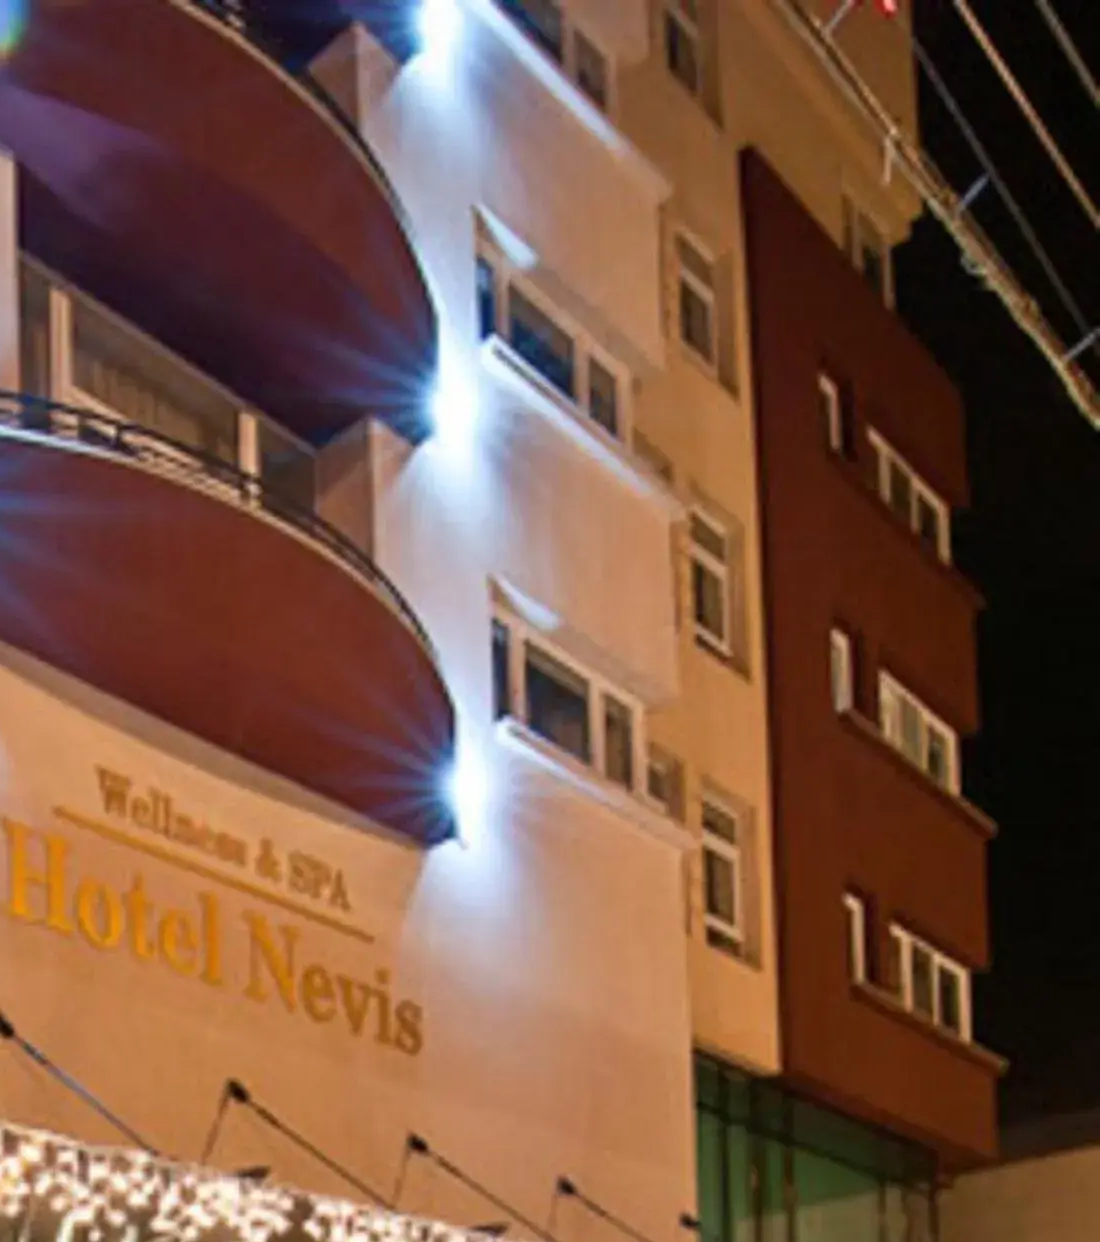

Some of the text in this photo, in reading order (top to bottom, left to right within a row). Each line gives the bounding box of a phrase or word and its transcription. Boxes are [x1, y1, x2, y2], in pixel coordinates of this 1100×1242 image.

[1, 815, 424, 1056] Hotel Nevis
[254, 836, 282, 884] &
[288, 849, 353, 913] SPA
